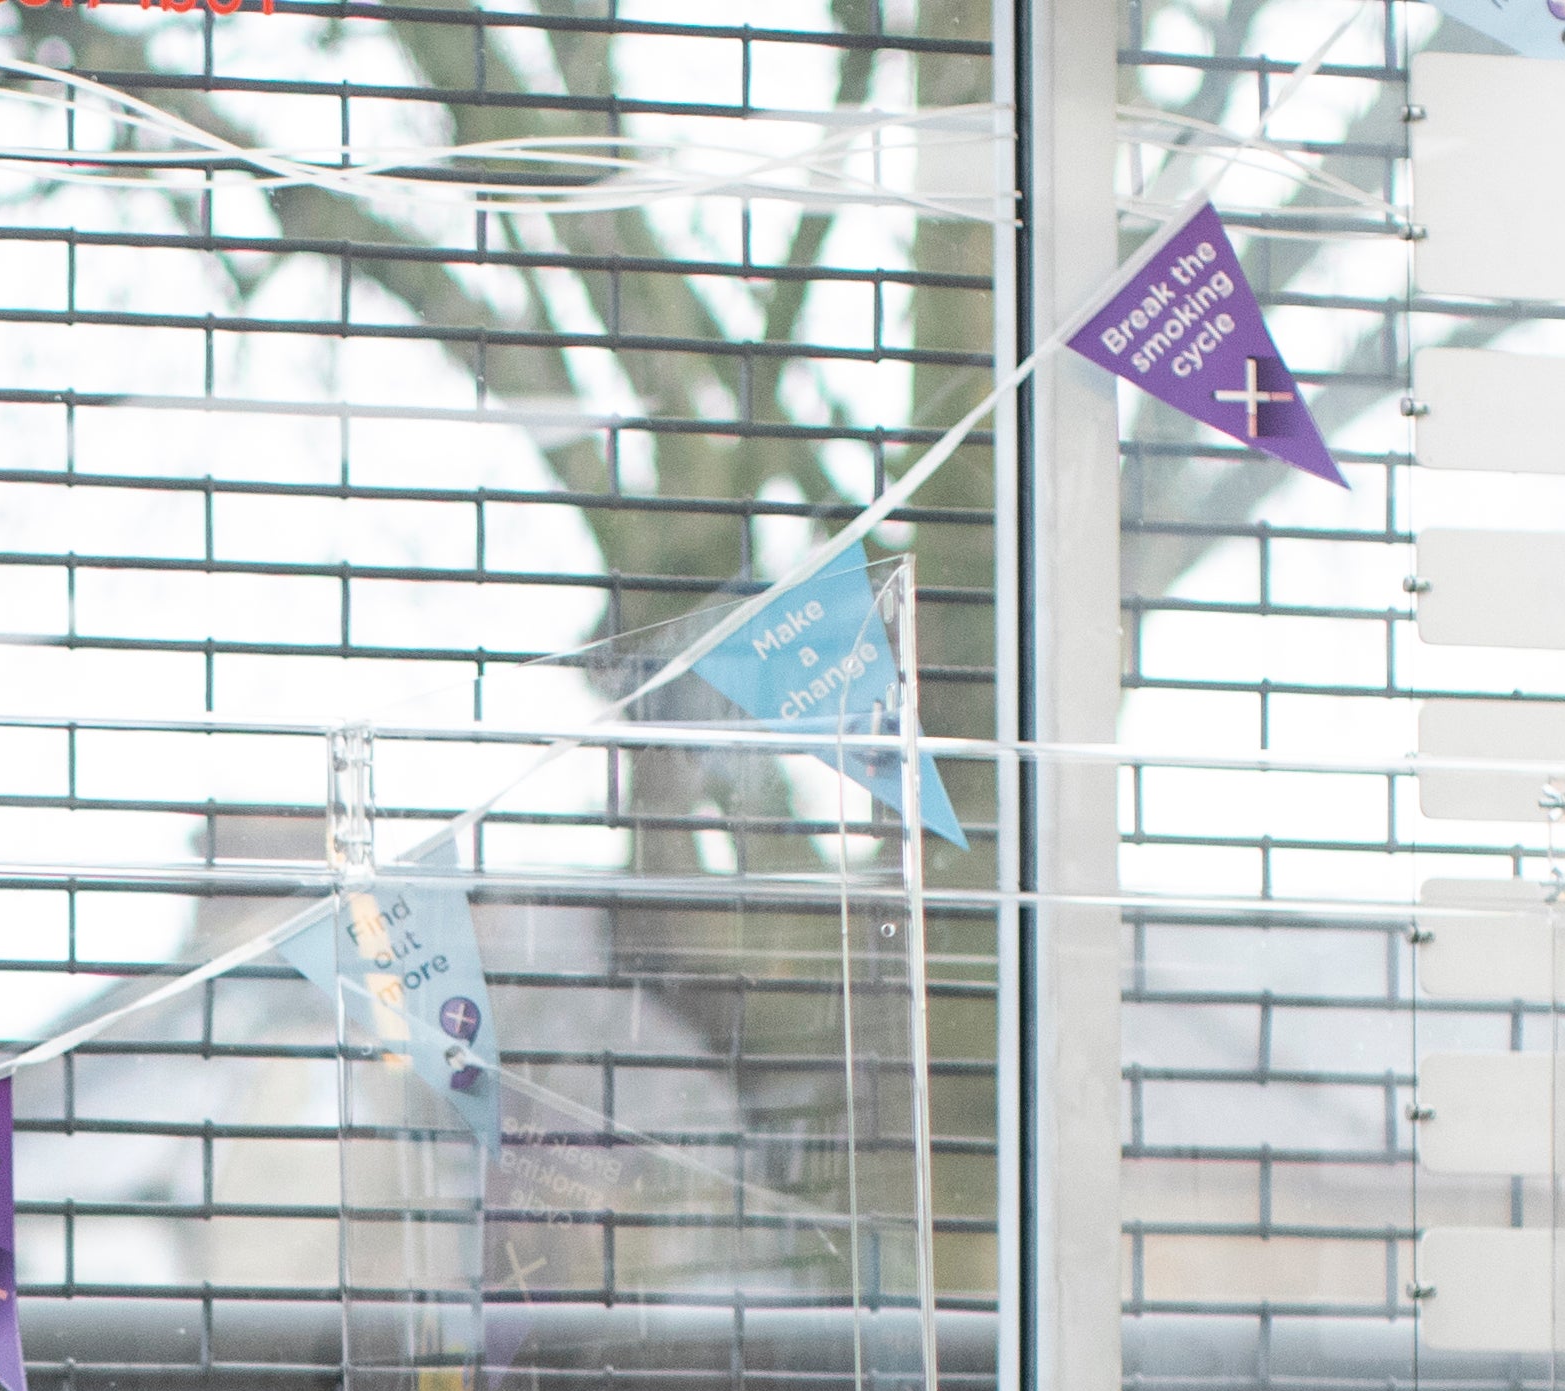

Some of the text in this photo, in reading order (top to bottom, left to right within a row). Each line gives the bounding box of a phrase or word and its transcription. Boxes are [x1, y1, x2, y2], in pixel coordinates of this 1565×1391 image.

[1100, 241, 1217, 355] Break the
[1131, 270, 1235, 373] smoking
[1171, 313, 1235, 377] cycle
[752, 600, 825, 660] Make
[798, 646, 819, 667] a
[781, 643, 878, 720] change
[346, 893, 411, 945] Find
[374, 930, 421, 969] out
[378, 955, 449, 1006] more
